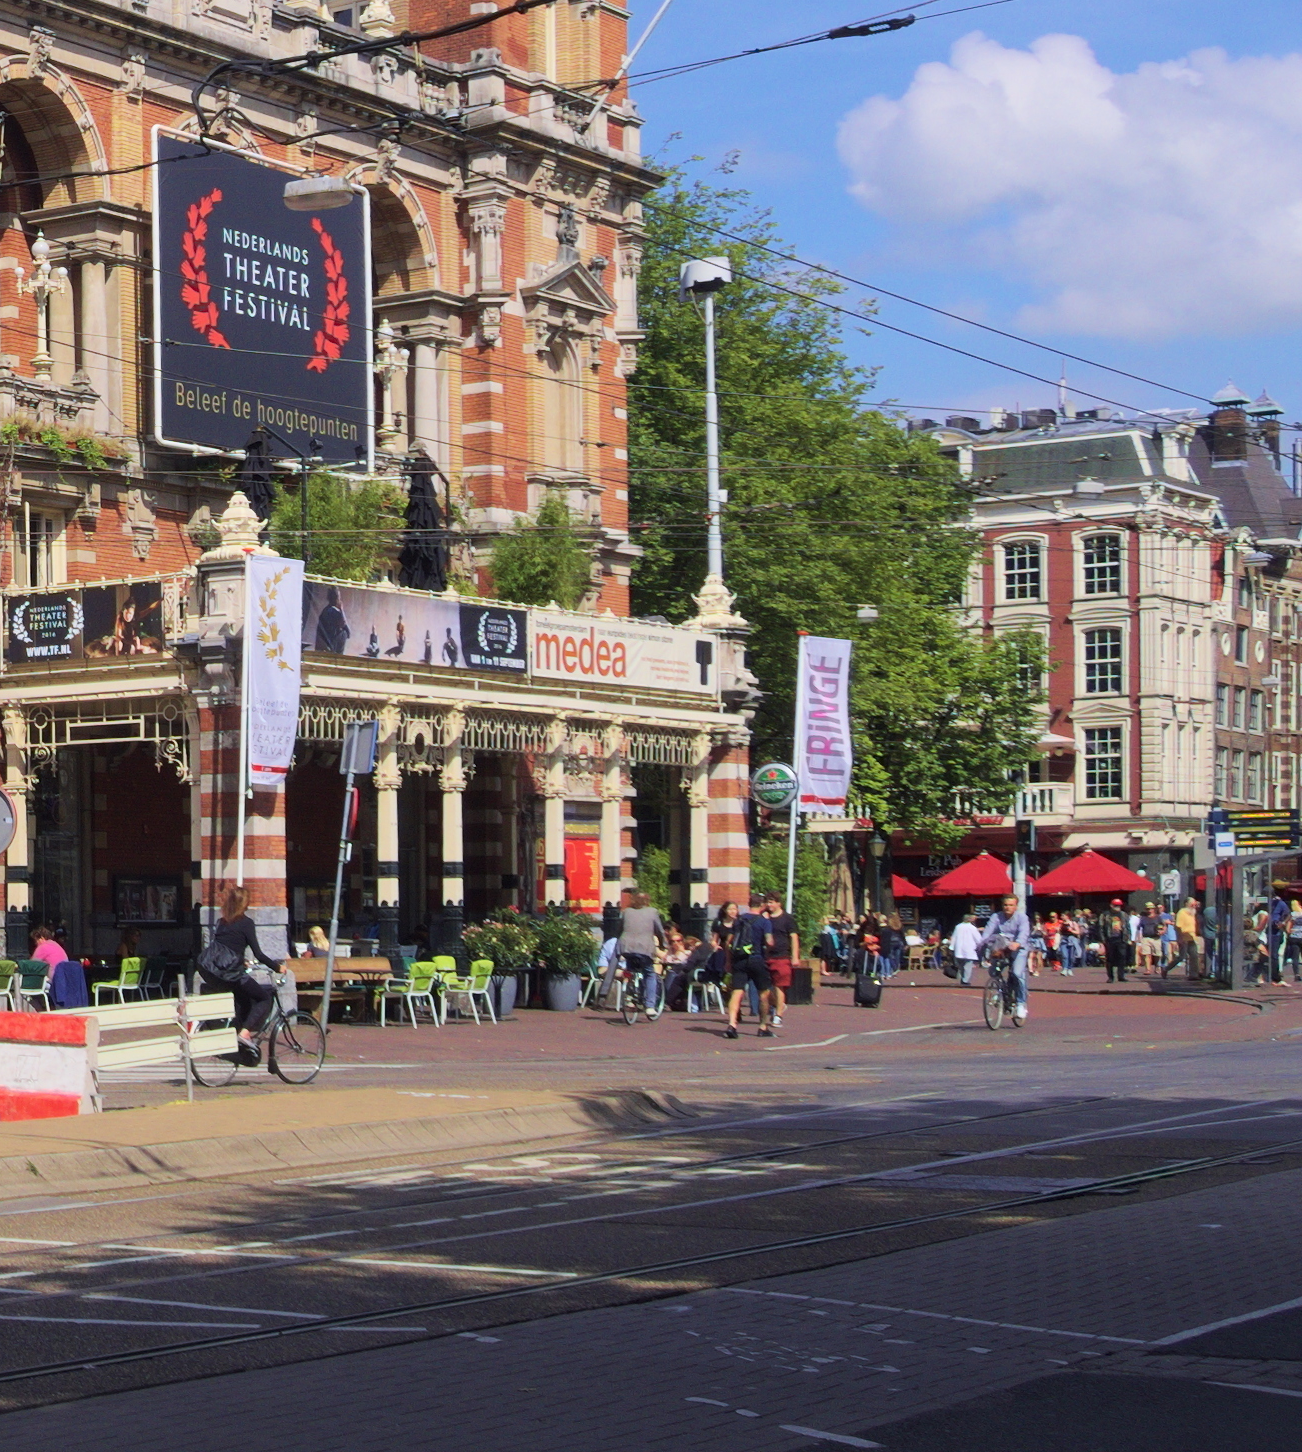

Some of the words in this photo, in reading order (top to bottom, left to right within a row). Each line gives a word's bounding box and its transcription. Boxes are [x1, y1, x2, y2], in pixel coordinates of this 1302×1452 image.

[222, 227, 309, 266] NEDERLANDS
[223, 252, 310, 298] THEATER
[223, 286, 311, 331] FESTIVAL
[175, 381, 227, 415] Beleef
[233, 393, 251, 420] de
[257, 398, 358, 441] hoogtepunten
[29, 611, 68, 622] THEATER
[29, 620, 68, 631] FESTIVAL
[25, 643, 73, 658] WWW.TF.NL
[535, 626, 627, 678] medea
